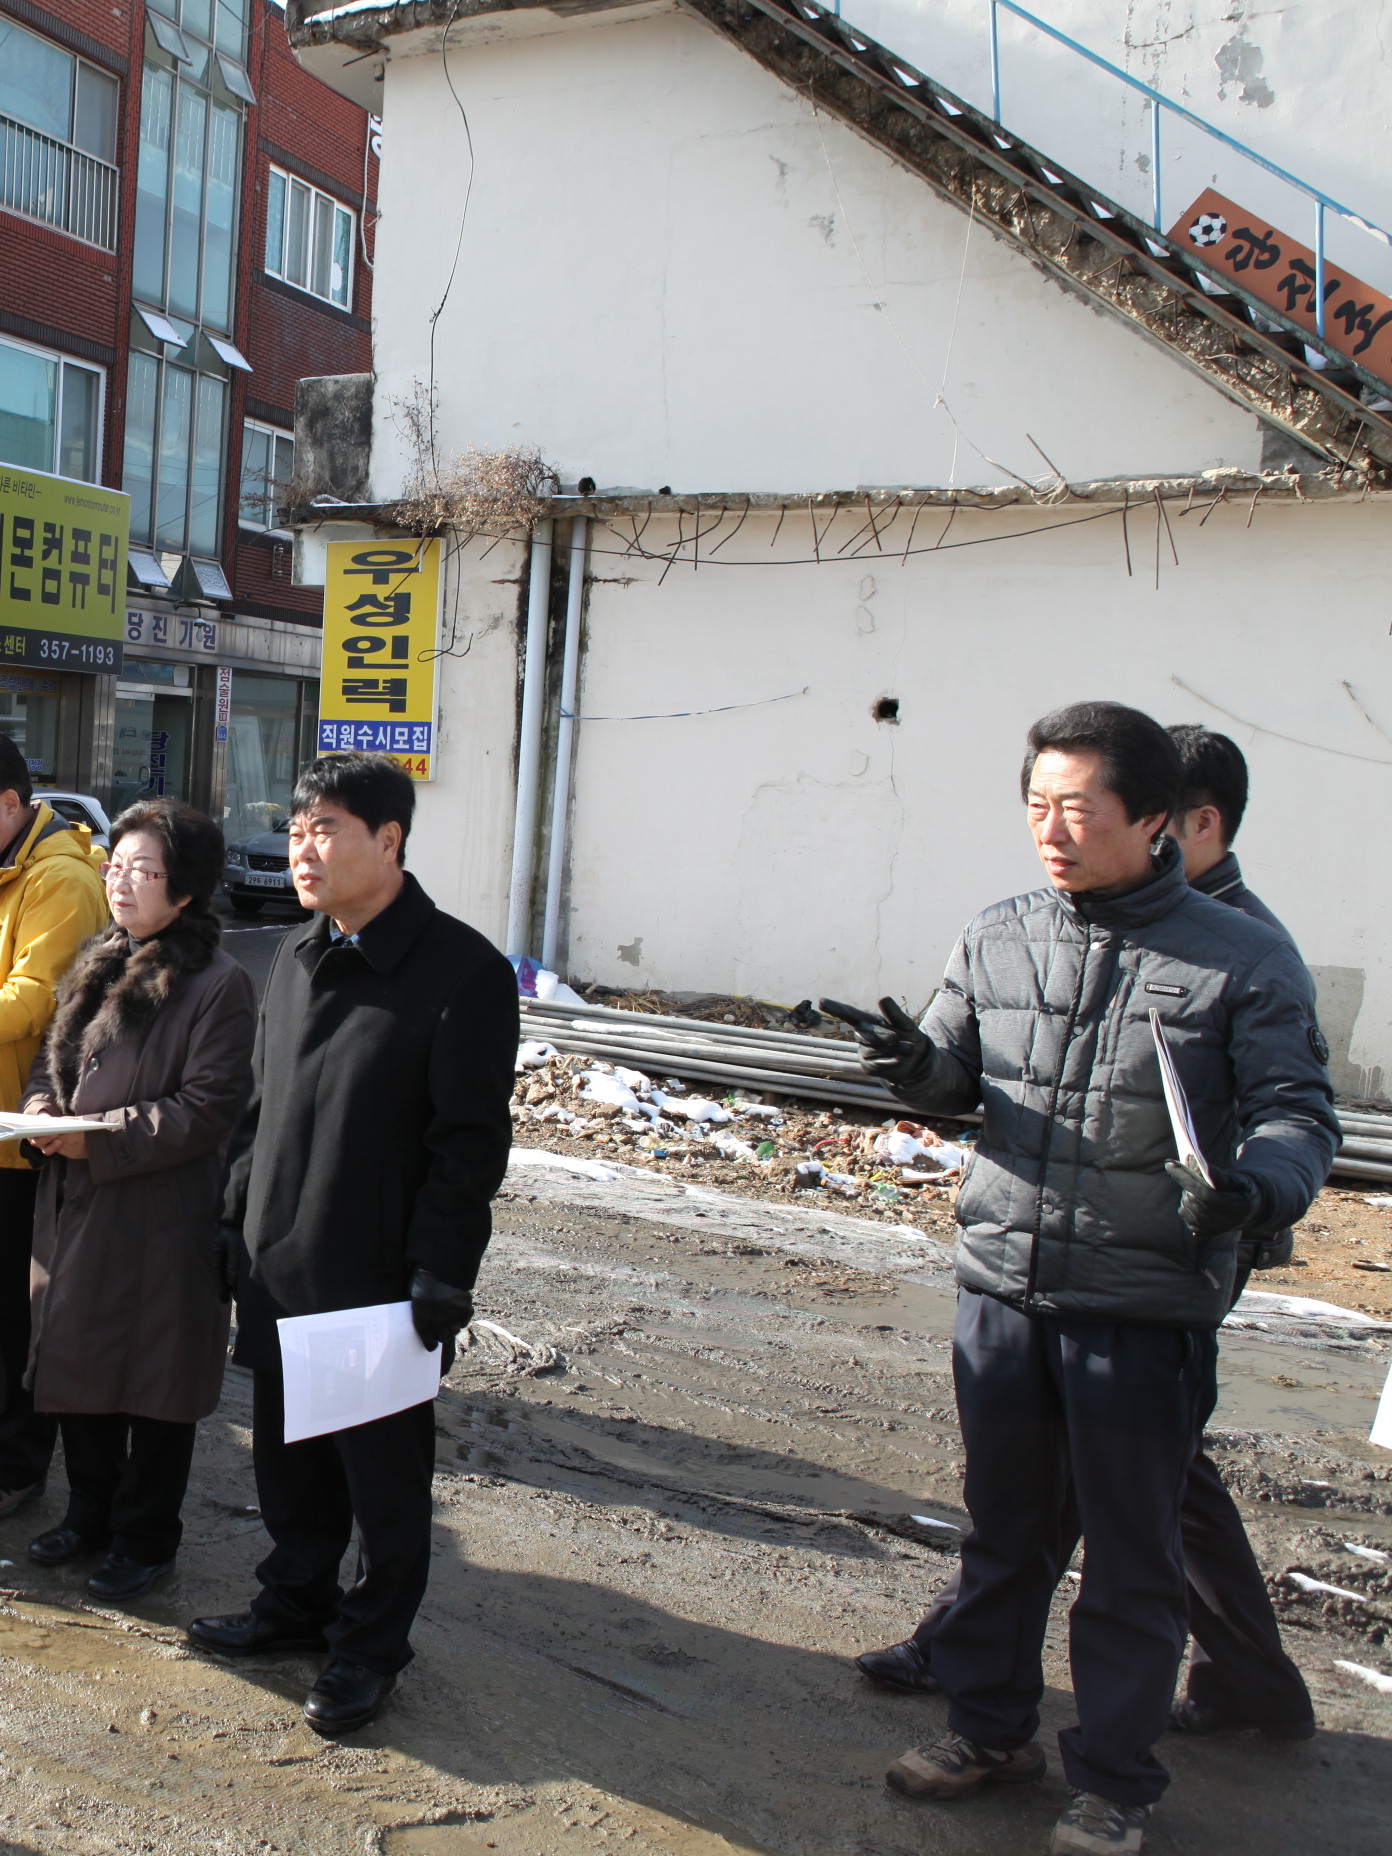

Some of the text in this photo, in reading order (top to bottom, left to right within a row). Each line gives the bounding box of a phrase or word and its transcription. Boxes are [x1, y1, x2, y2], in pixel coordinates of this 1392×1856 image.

[341, 549, 420, 714] 우성인력
[40, 638, 115, 666] 357-1193
[321, 723, 429, 752] 직원수시모집
[263, 878, 281, 887] 6911
